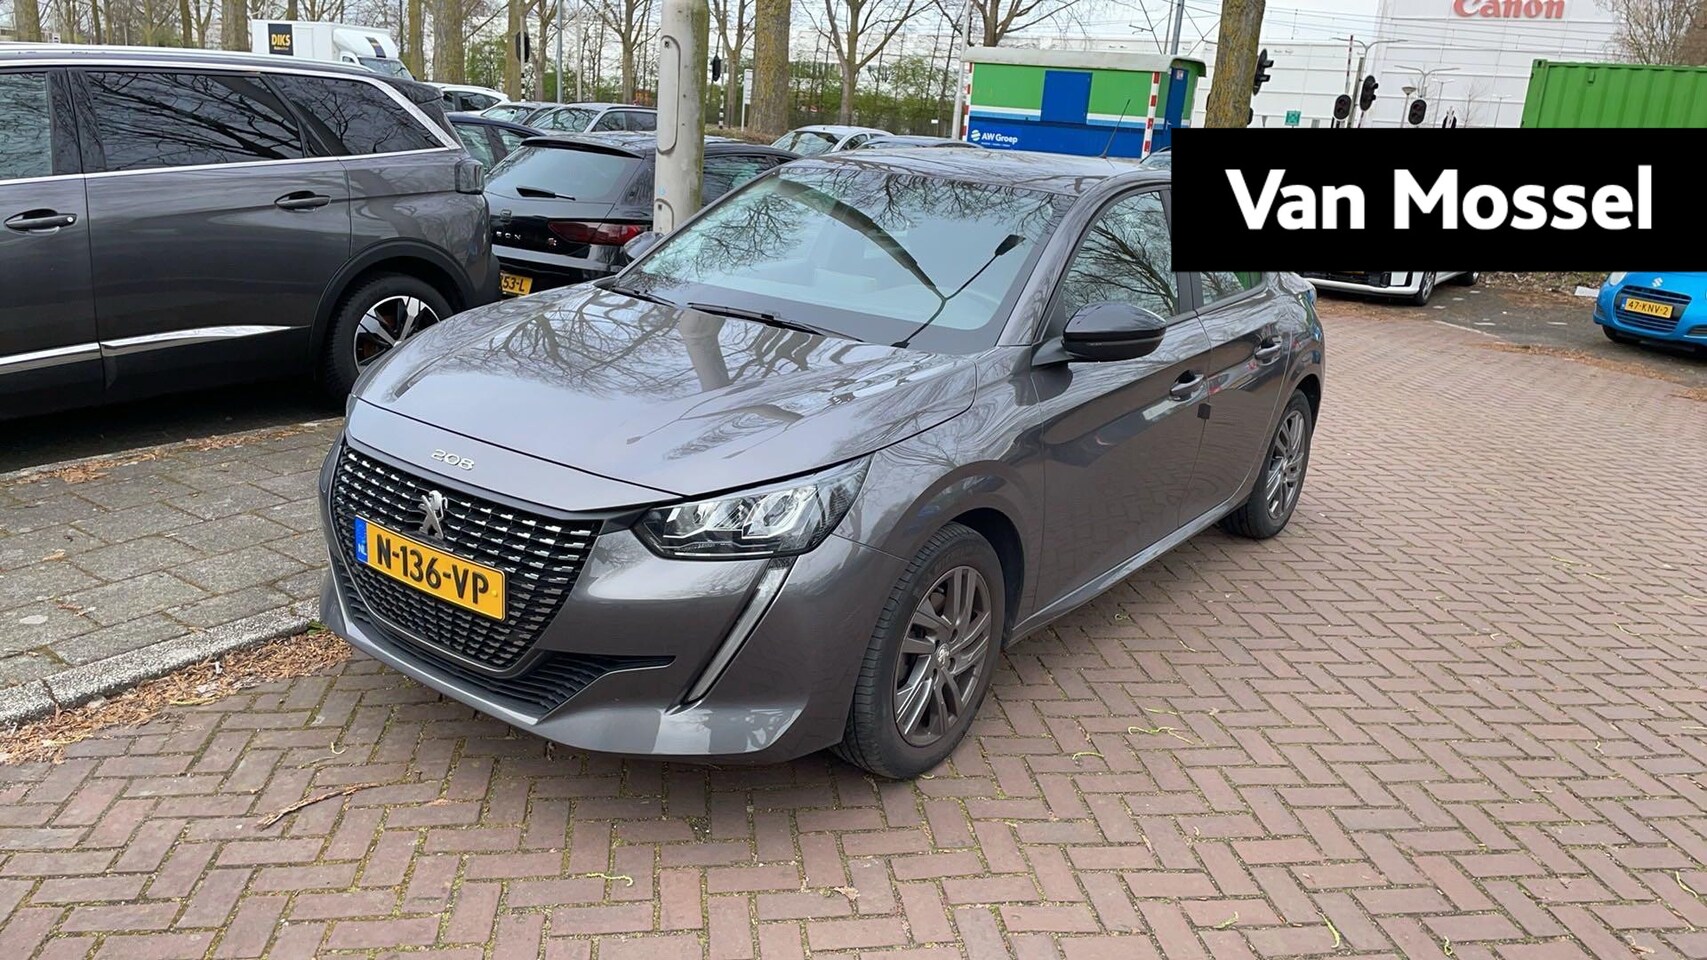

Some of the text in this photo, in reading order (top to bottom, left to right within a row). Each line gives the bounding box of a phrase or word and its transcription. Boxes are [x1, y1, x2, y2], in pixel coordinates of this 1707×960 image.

[1453, 0, 1565, 19] Canon
[271, 34, 291, 46] DIKS
[981, 132, 996, 142] AW
[995, 133, 1018, 145] Groep
[500, 275, 525, 292] 53-L
[431, 449, 475, 470] 208
[377, 534, 489, 604] N-136-VP
